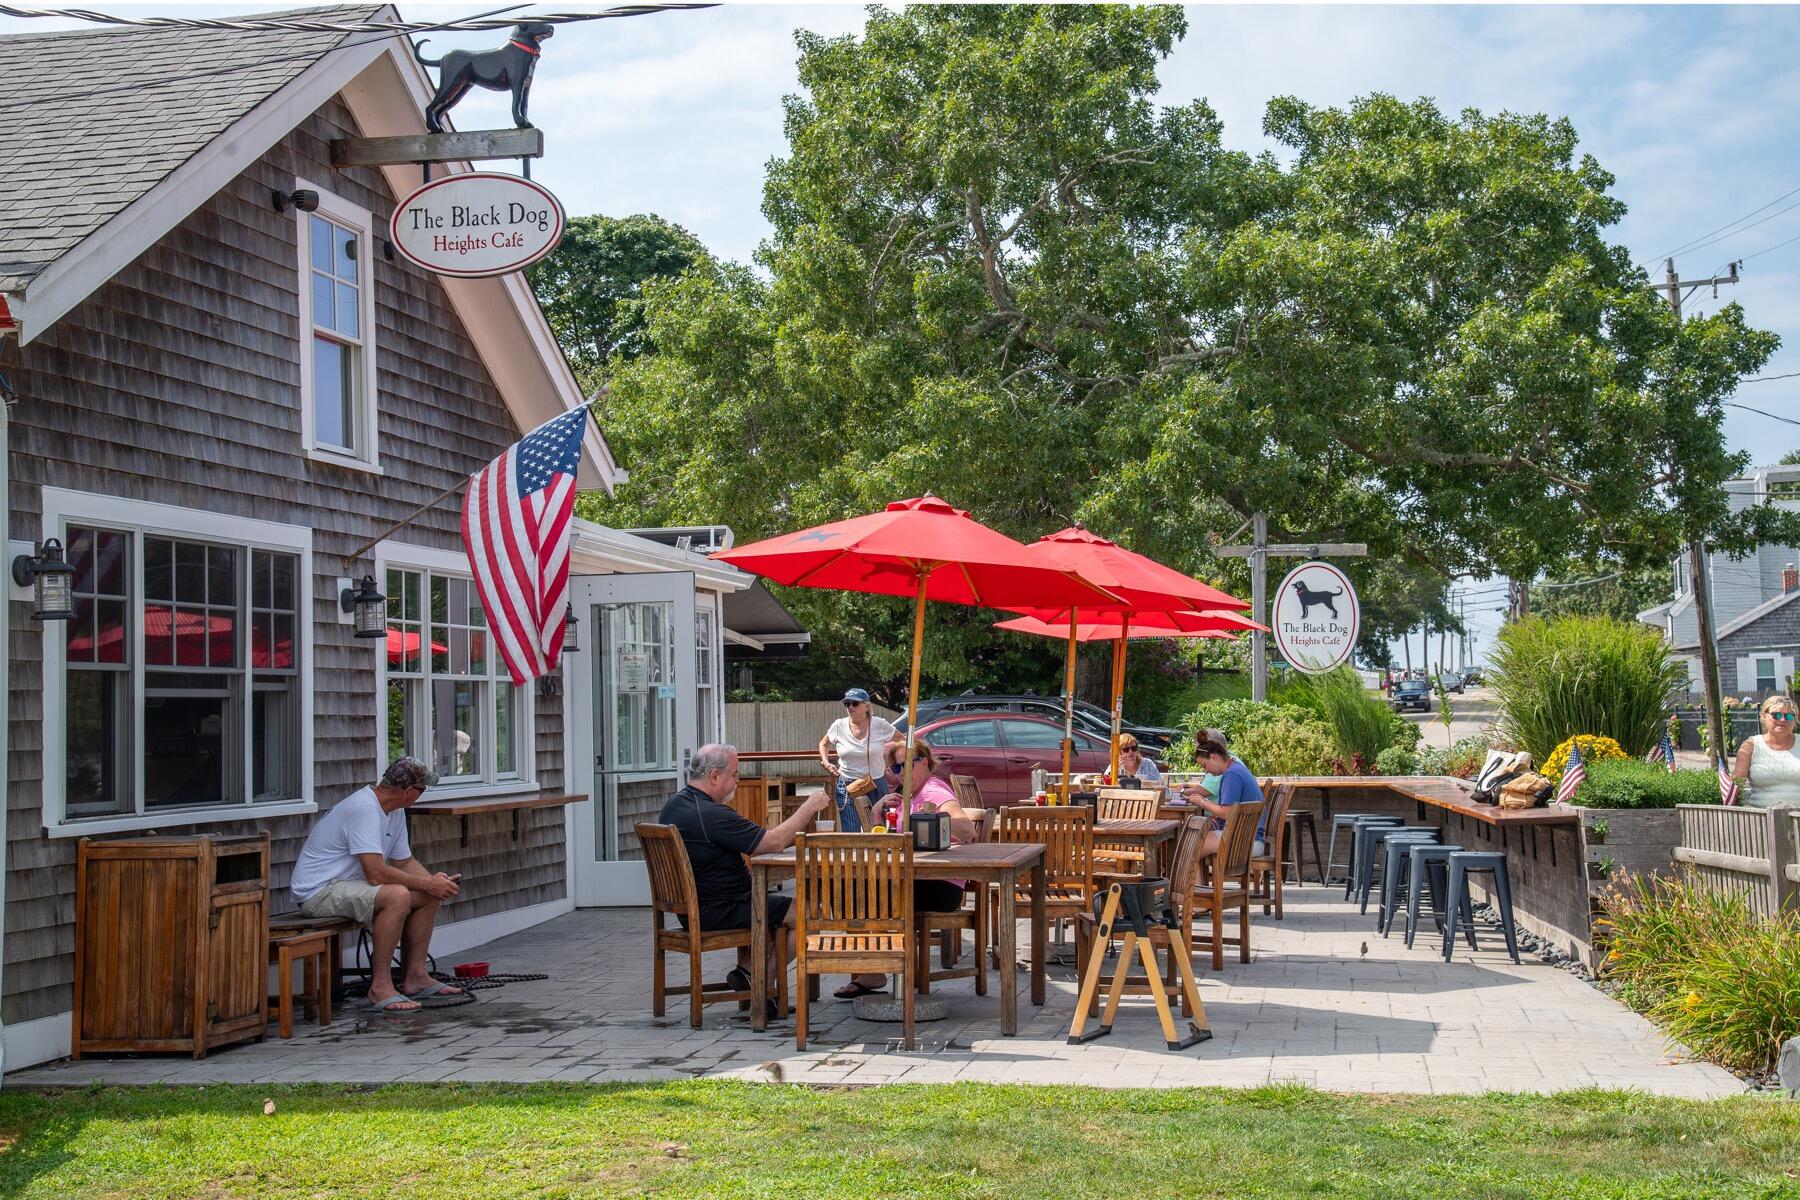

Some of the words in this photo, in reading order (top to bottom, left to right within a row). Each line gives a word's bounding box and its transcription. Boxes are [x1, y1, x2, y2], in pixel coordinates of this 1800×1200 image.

[409, 208, 443, 229] The
[451, 204, 500, 227] Black
[508, 202, 548, 231] Dog
[433, 235, 487, 255] Heights
[491, 232, 523, 248] Café
[1283, 623, 1299, 632] The
[1303, 623, 1326, 633] Black
[1329, 623, 1348, 637] Dog
[1290, 636, 1320, 647] Heights
[1322, 635, 1340, 645] Café
